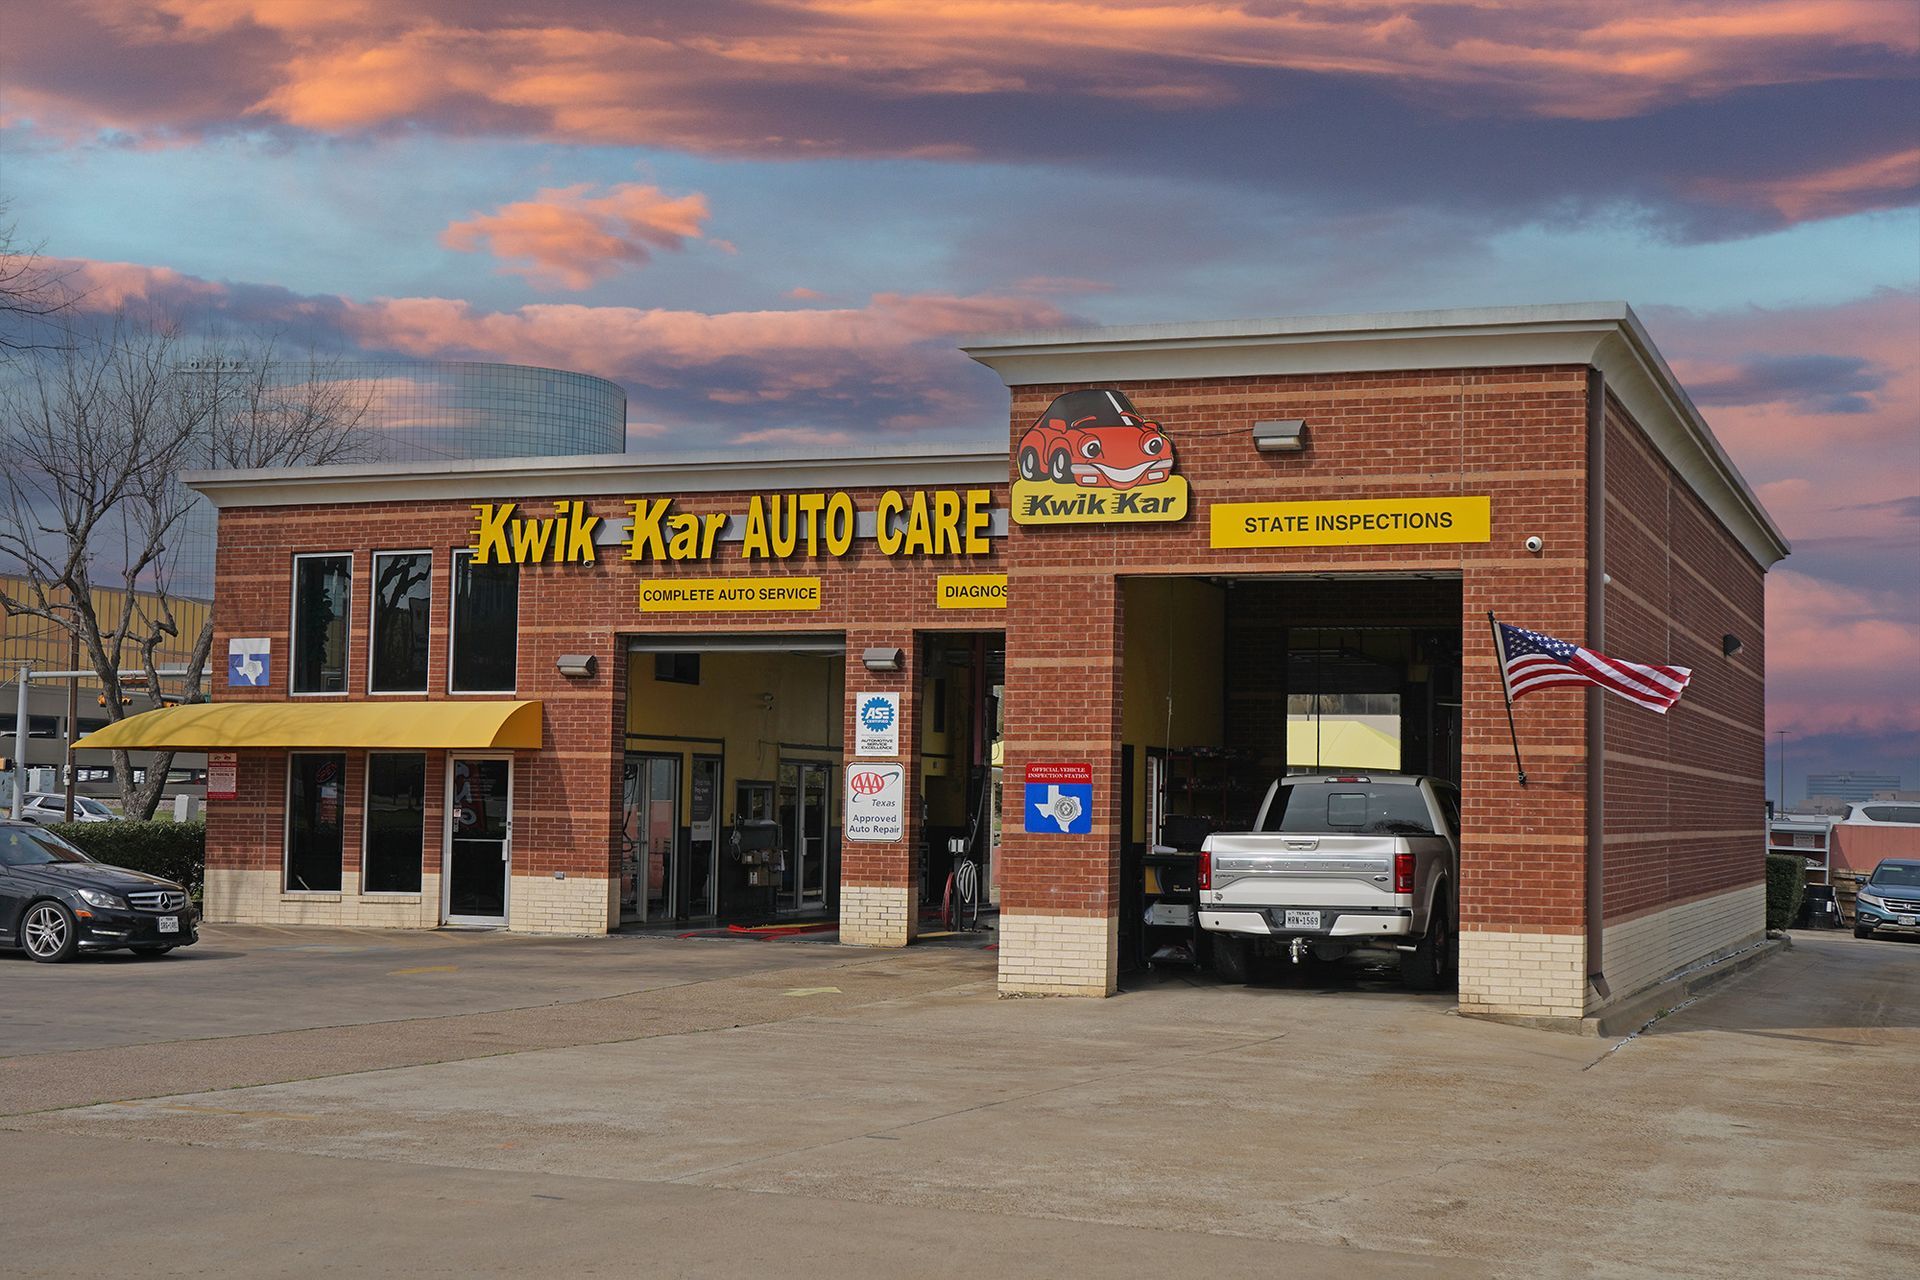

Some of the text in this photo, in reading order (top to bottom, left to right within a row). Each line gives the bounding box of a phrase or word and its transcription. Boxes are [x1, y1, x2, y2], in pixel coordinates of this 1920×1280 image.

[1021, 492, 1176, 516] Kwik Kar
[469, 489, 991, 563] Kwik Kar AUTO CARE
[1244, 511, 1453, 533] STATE INSPECTIONS
[643, 587, 817, 602] COMPLETE AUTO SERVICE
[945, 585, 1007, 598] DIAGNOS
[865, 707, 890, 719] ASE
[854, 774, 881, 794] AAA
[853, 815, 897, 823] Approved
[849, 825, 900, 834] Auto Repair
